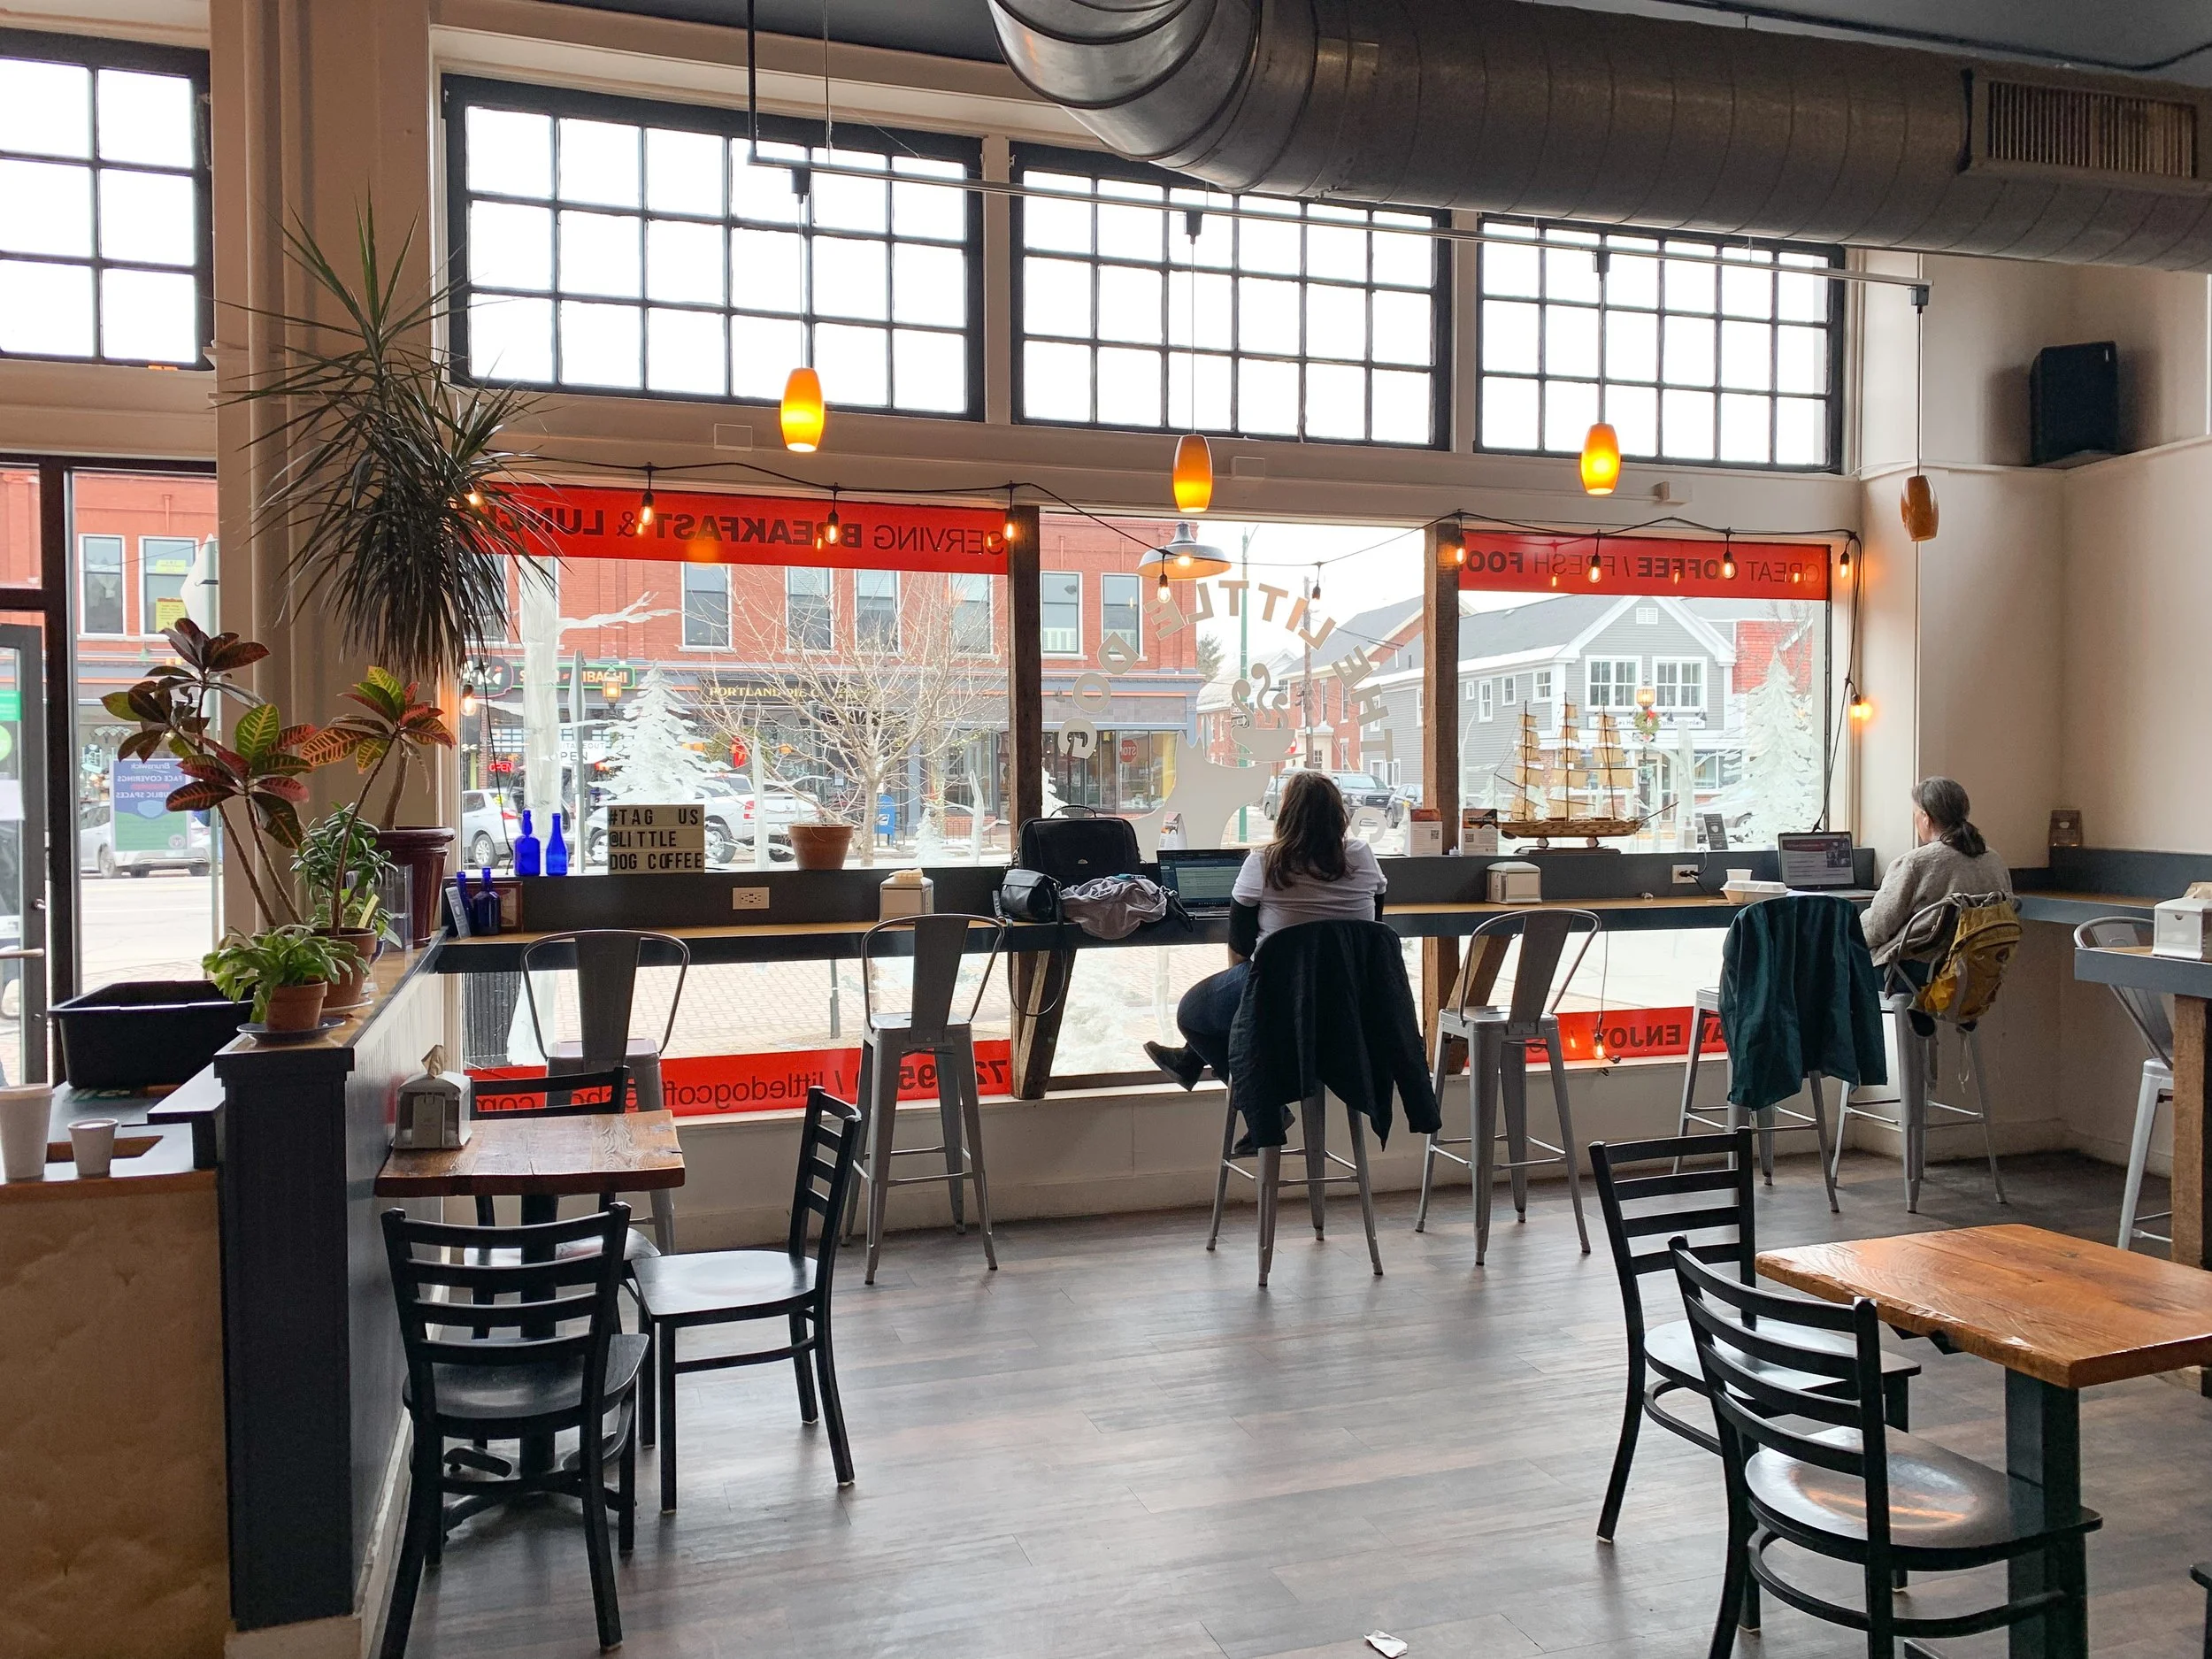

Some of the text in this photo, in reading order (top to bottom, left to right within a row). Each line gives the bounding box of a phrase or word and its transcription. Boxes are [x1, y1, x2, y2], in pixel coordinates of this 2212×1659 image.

[582, 670, 627, 683] IBAHI
[709, 687, 780, 697] PORTLAND
[610, 808, 699, 826] #TAG US
[610, 831, 677, 848] @LITTLE
[610, 852, 703, 870] DOG COFFEE
